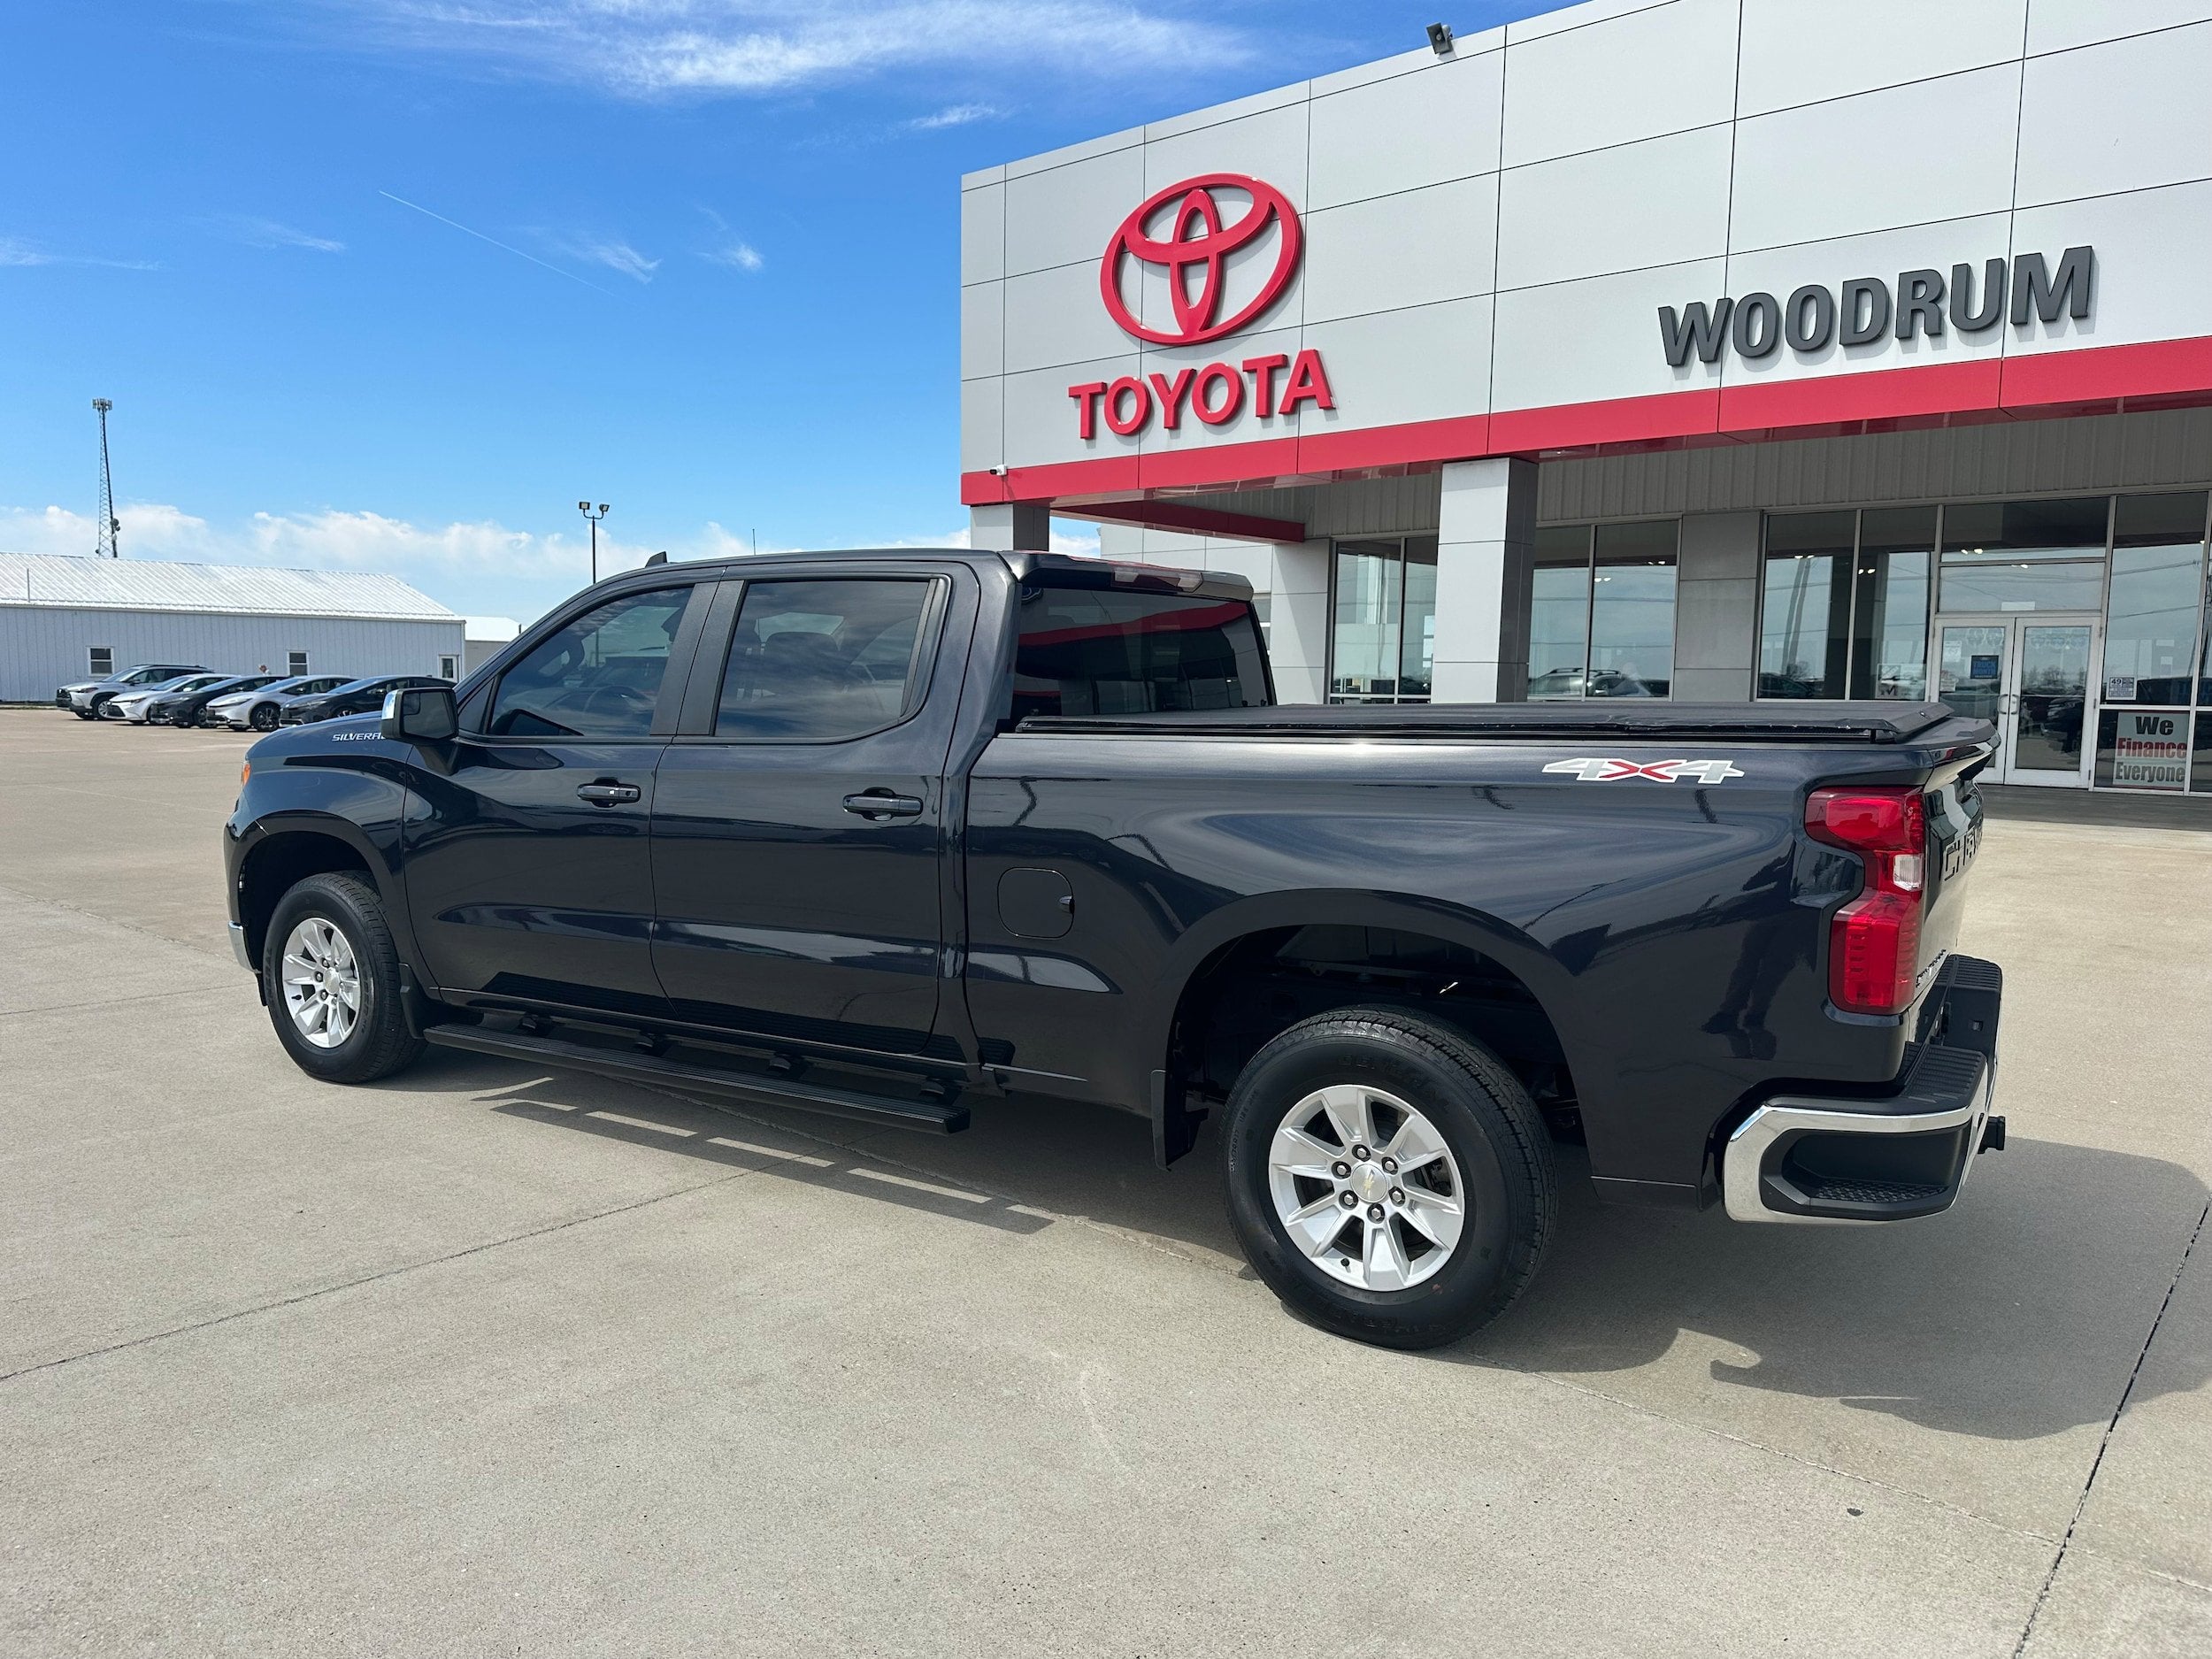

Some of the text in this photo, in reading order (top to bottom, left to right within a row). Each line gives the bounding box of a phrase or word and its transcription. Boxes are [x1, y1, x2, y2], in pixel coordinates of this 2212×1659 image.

[1658, 245, 2093, 366] WOODRUM
[1068, 349, 1336, 440] TOYOTA
[2135, 716, 2174, 735] We
[331, 732, 386, 741] SILVERA
[2116, 737, 2188, 759] Finance
[2115, 762, 2186, 783] Everyone
